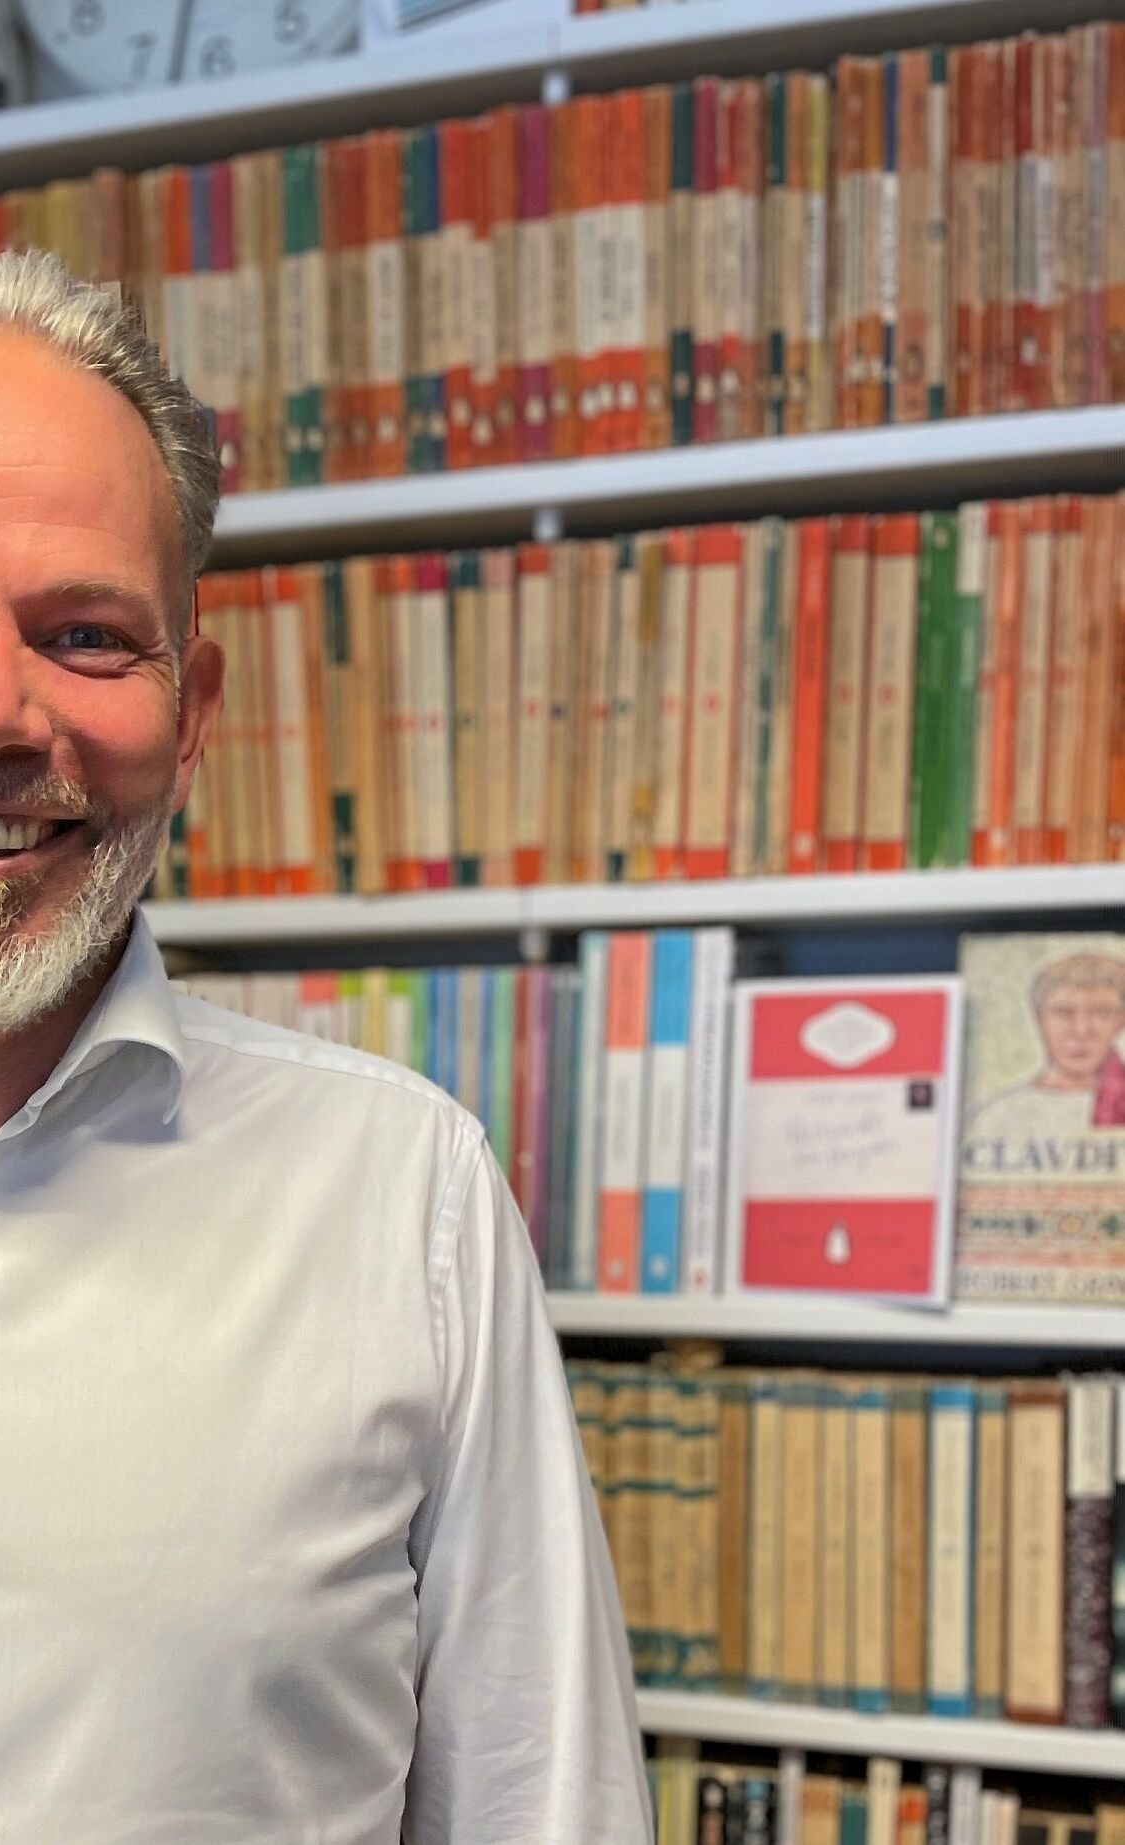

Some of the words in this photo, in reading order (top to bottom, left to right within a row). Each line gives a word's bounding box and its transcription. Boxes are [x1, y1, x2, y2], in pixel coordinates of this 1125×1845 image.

[126, 30, 159, 81] 7
[200, 34, 236, 82] 6
[960, 1136, 1125, 1172] CLAVDI
